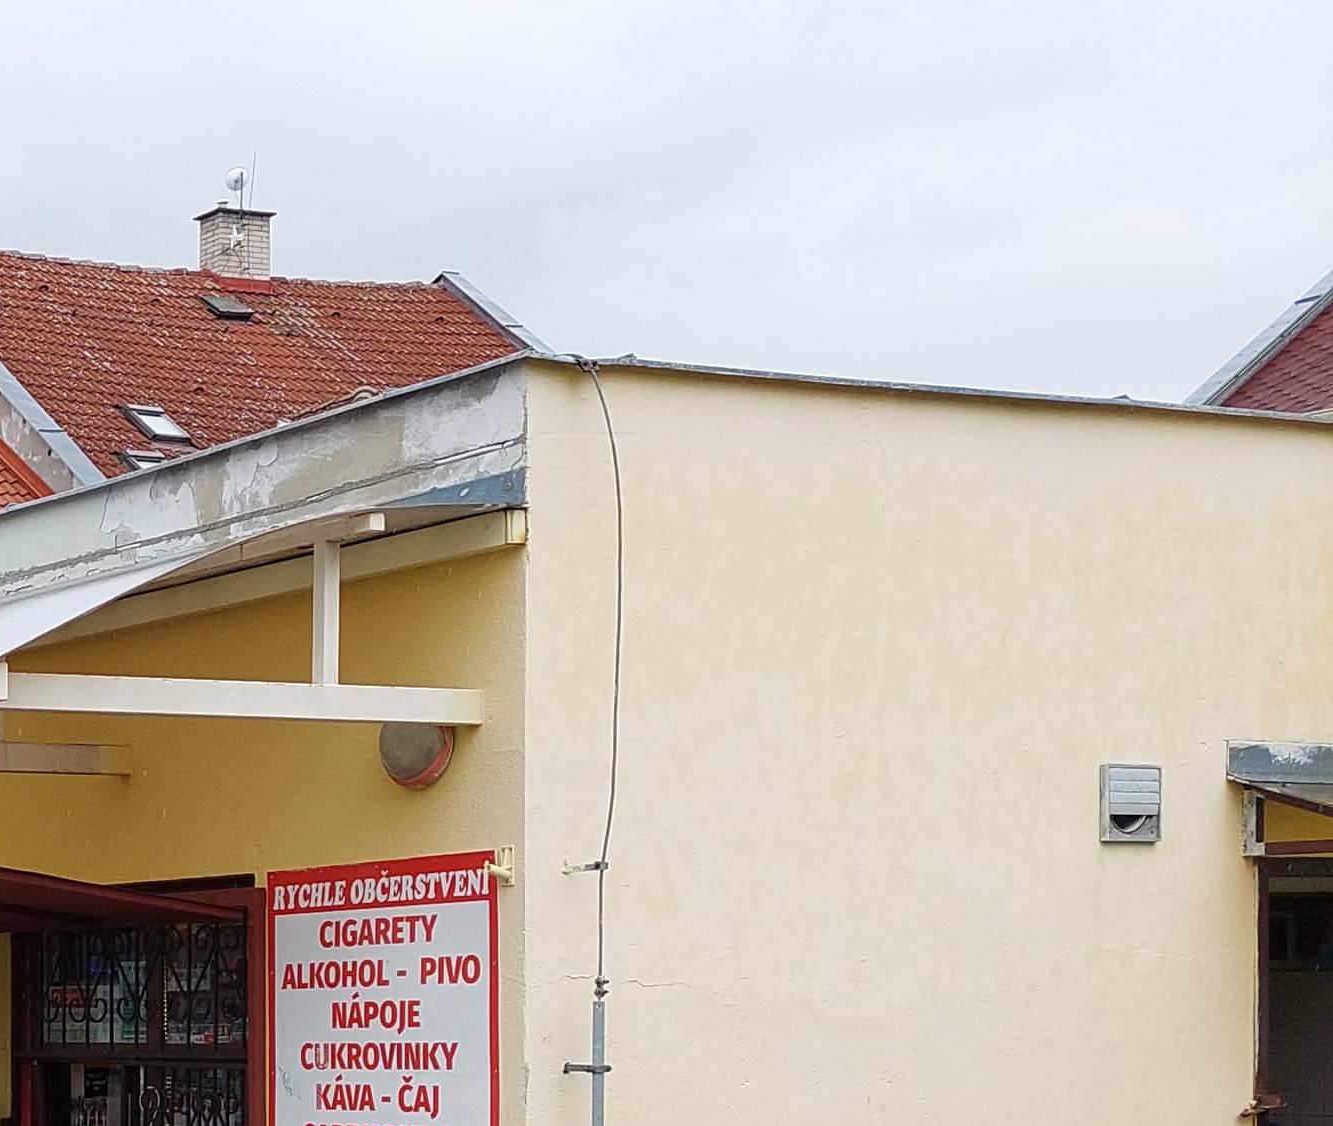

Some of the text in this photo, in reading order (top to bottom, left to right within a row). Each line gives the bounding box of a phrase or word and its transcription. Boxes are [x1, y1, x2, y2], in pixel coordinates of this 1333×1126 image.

[350, 859, 490, 905] OBČERSTVENÍ
[319, 914, 438, 948] CIGARETY
[282, 958, 390, 990] ALKOHOL
[420, 954, 481, 985] PIVO
[332, 991, 421, 1035] NÁPOJE
[300, 1042, 459, 1071] CUKROVINKY
[316, 1074, 375, 1111] KÁVA
[398, 1075, 440, 1119] ČAJ
